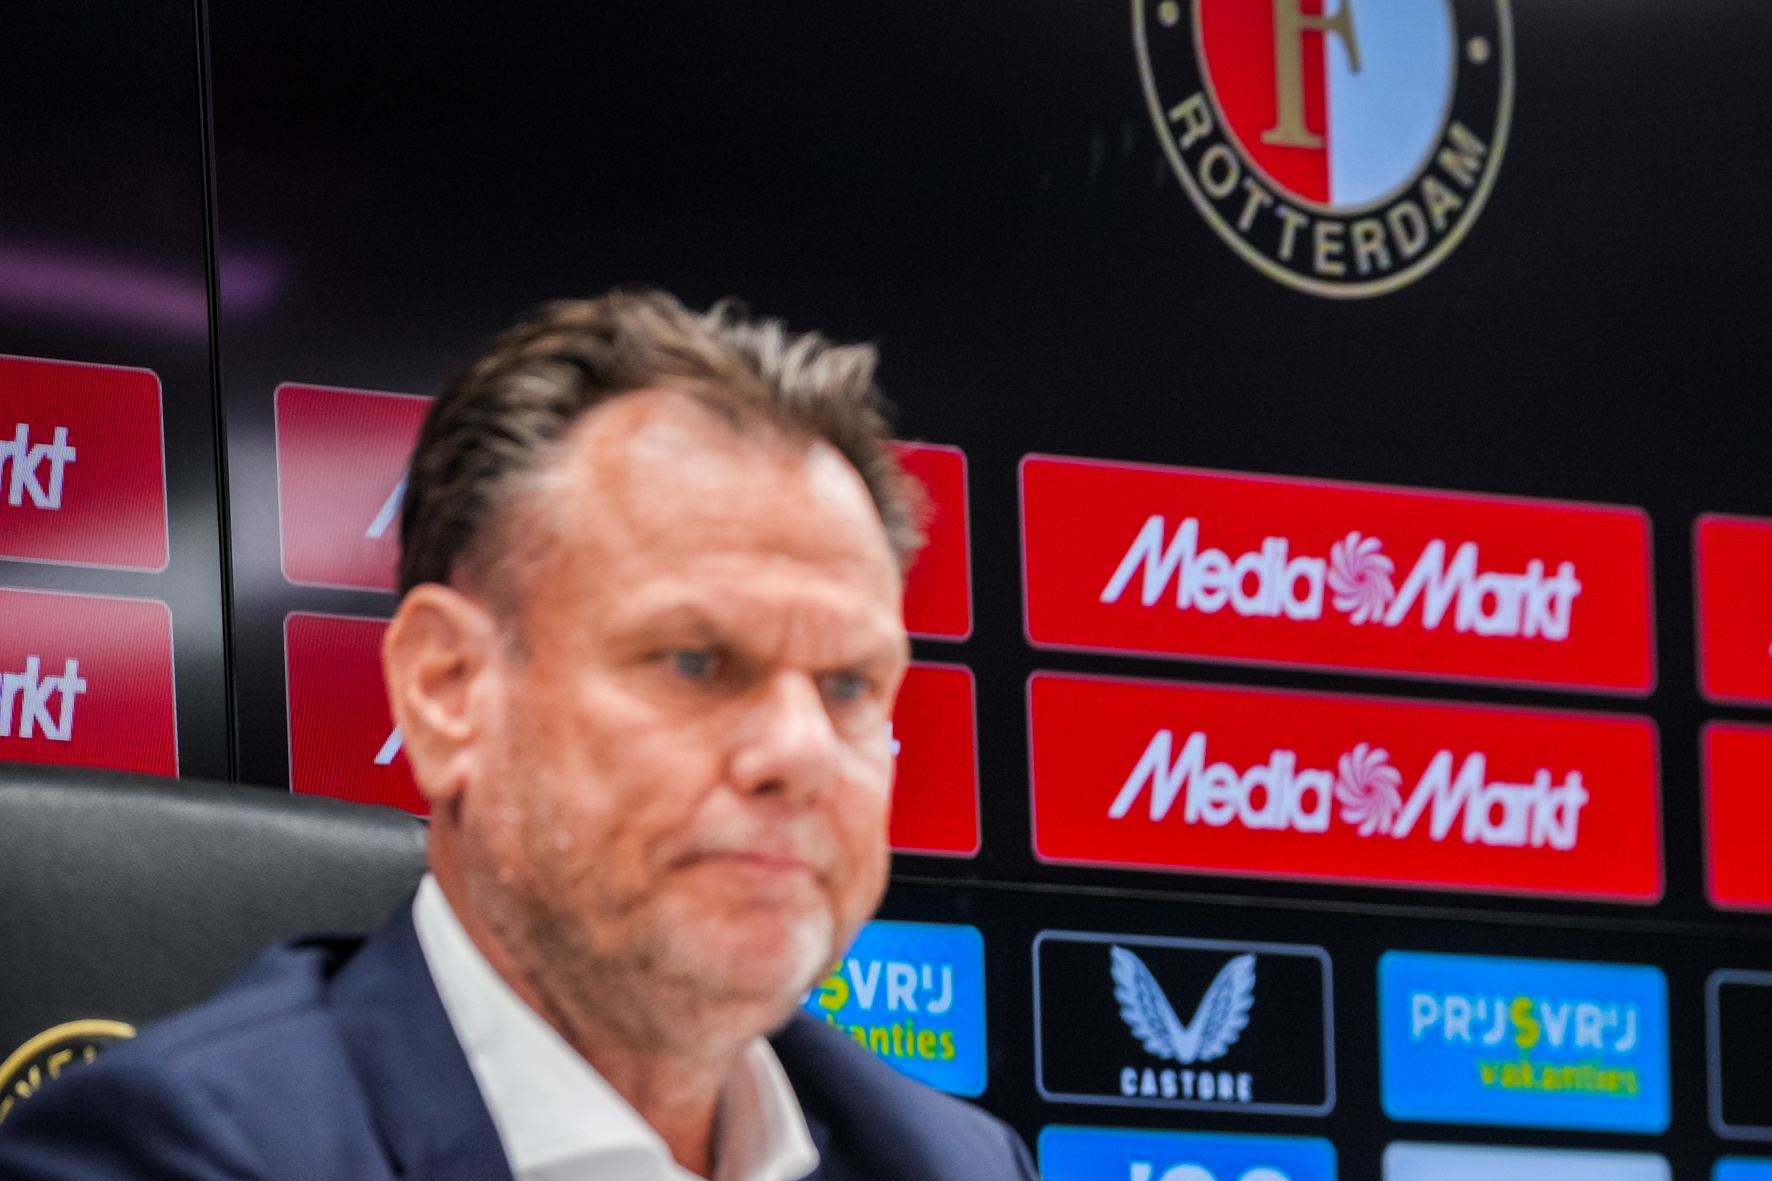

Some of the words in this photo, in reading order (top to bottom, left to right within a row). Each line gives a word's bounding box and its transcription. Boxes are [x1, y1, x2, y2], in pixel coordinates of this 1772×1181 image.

[1168, 92, 1488, 277] ROTTERDAM
[0, 422, 76, 510] rkt
[0, 655, 87, 741] rkt
[803, 958, 954, 1014] SVRIJ
[1120, 1065, 1254, 1103] CASTORE
